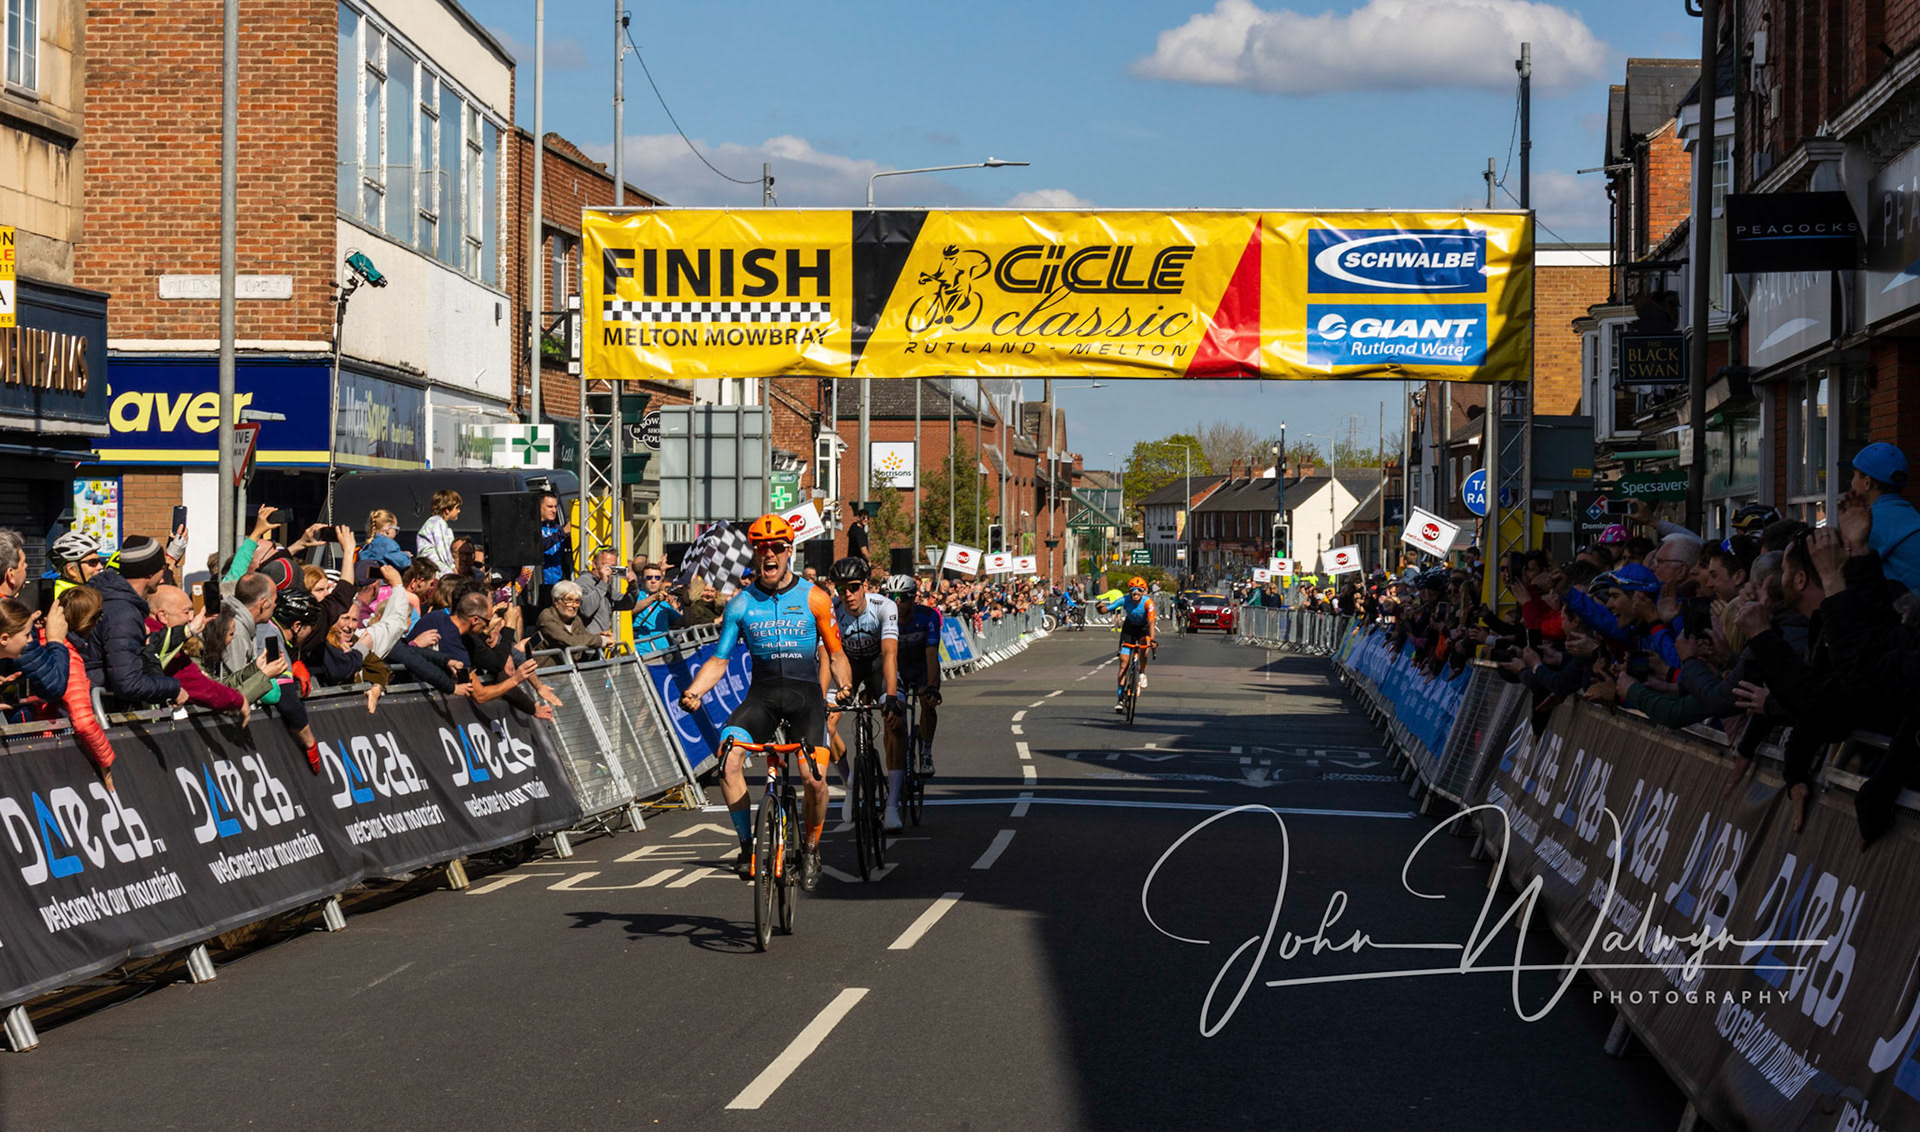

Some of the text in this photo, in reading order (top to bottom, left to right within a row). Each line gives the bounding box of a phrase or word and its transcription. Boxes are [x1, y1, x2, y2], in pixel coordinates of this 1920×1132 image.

[1736, 222, 1858, 235] PEACOCKS
[1343, 252, 1477, 268] SCHWALBE
[603, 247, 831, 297] FINISH
[991, 282, 1194, 338] classic
[603, 327, 698, 347] MELTON
[704, 328, 829, 347] MOWBRAY
[1349, 318, 1479, 340] GIANT
[904, 341, 1037, 354] RUTLAND
[1069, 342, 1189, 357] MELTON
[1351, 341, 1472, 357] Rutland Water
[1628, 348, 1680, 361] BLACK
[1629, 363, 1680, 377] SWAN
[107, 383, 253, 434] aver
[234, 431, 251, 444] IVE
[875, 467, 912, 478] orrisons
[1621, 480, 1689, 496] Specsavers
[750, 619, 808, 630] RIBBLE
[761, 640, 798, 649] HUUB
[770, 652, 803, 660] DURATA
[275, 828, 325, 867] mountain
[39, 895, 101, 933] welcome
[108, 886, 131, 915] our
[126, 866, 188, 909] mountain
